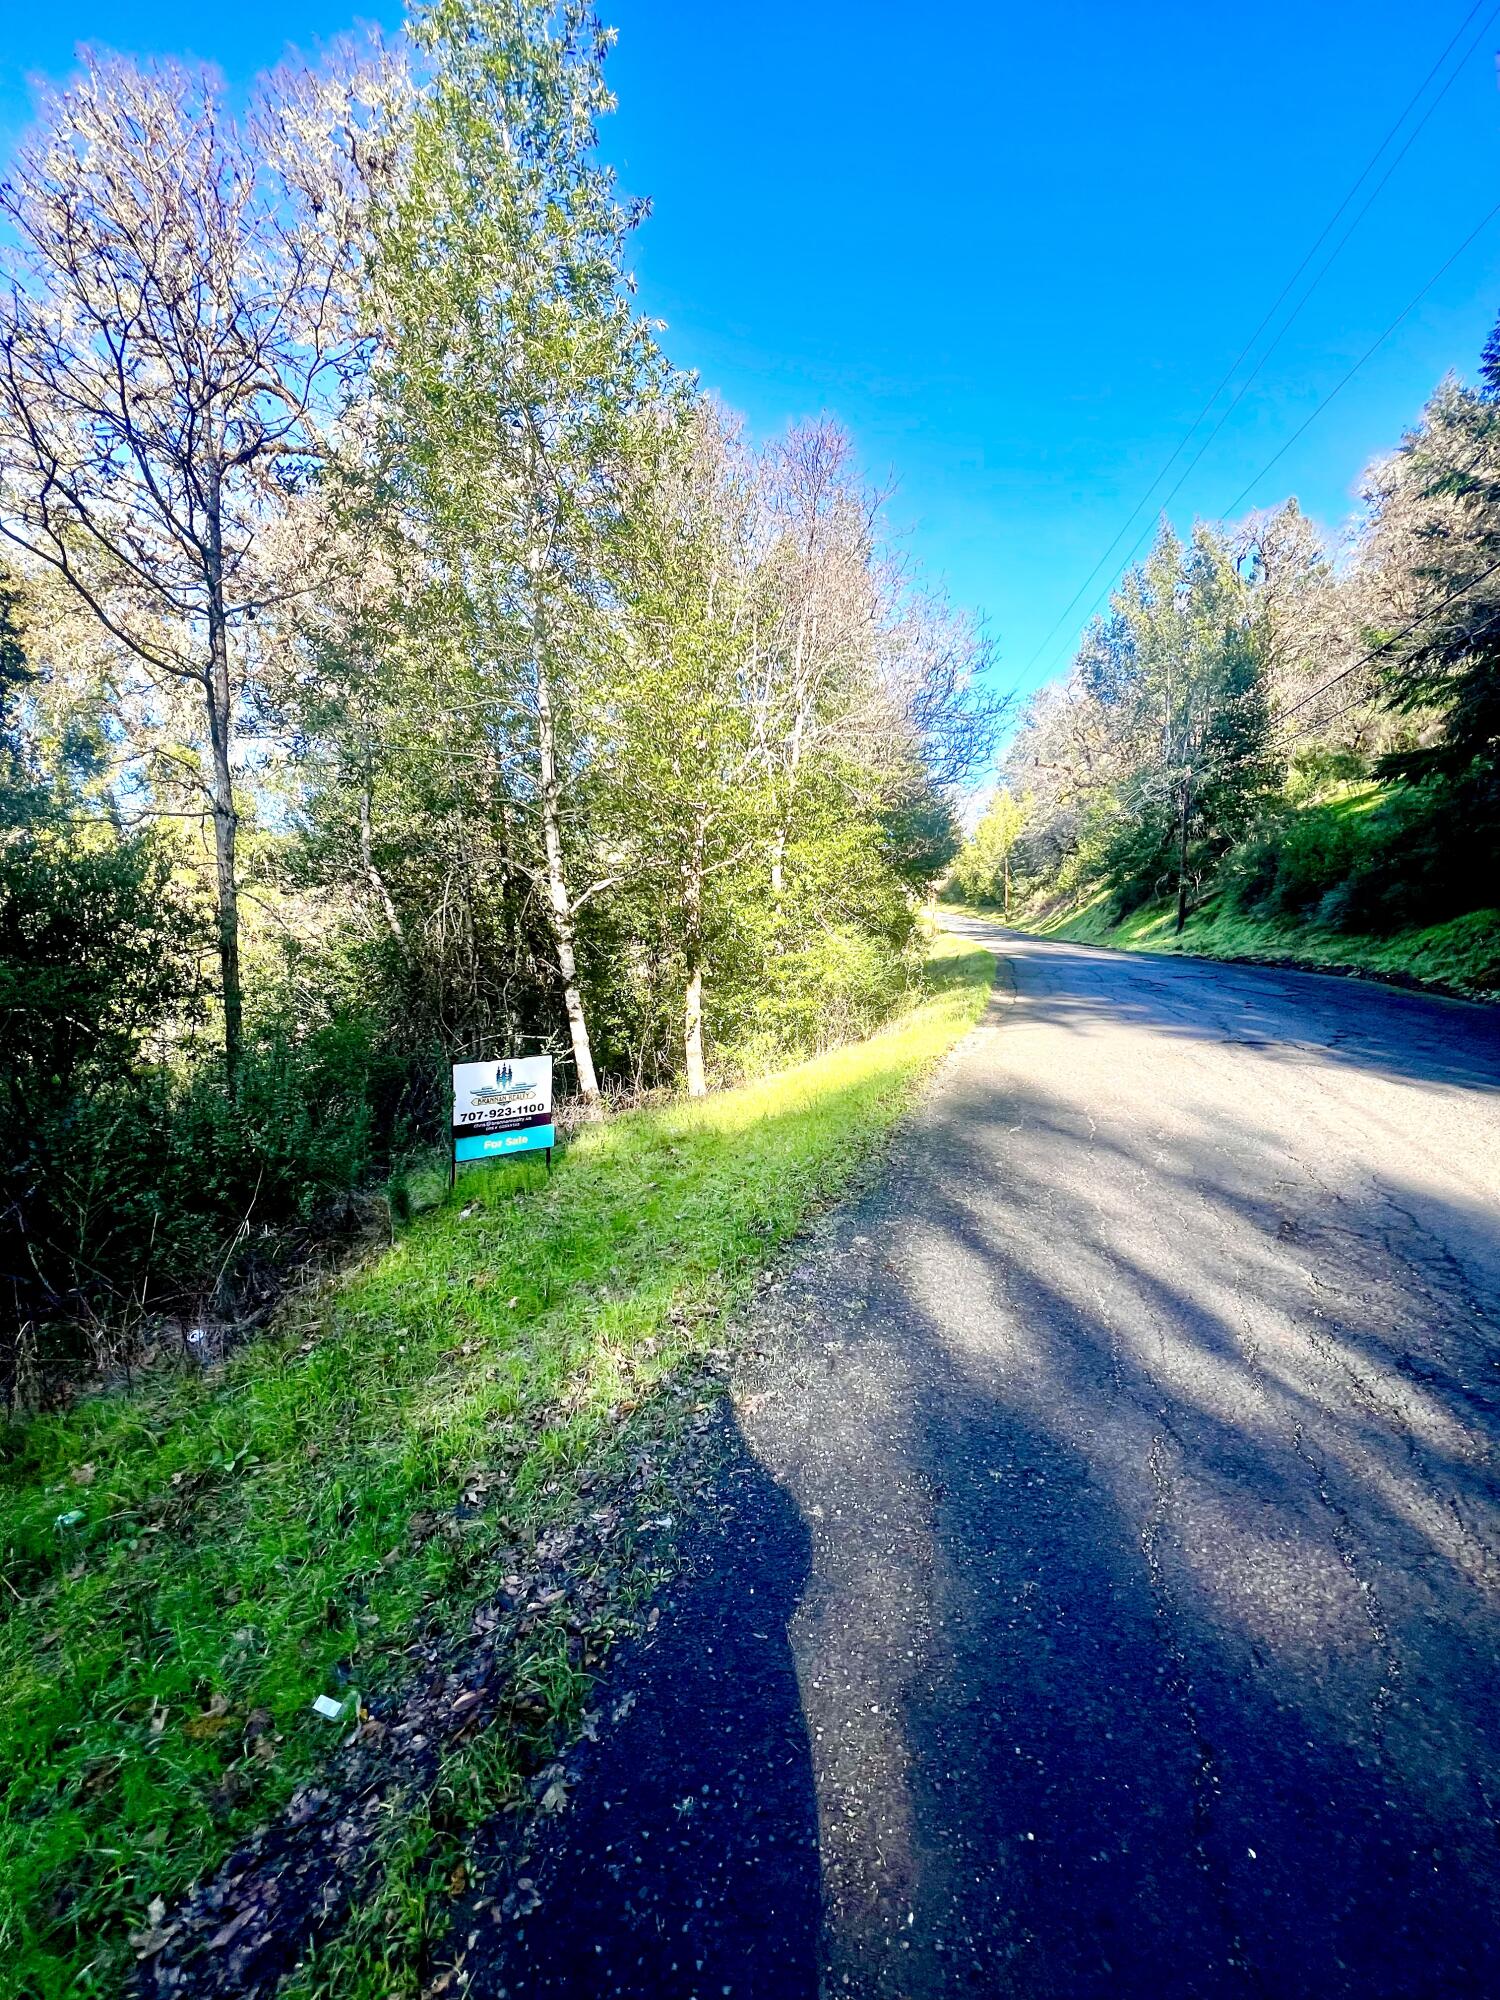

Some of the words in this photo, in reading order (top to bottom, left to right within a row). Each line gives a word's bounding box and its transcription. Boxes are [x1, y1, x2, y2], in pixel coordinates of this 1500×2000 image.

[460, 1103, 544, 1122] 707-923-1100
[484, 1140, 503, 1150] For
[505, 1136, 528, 1146] Sale
